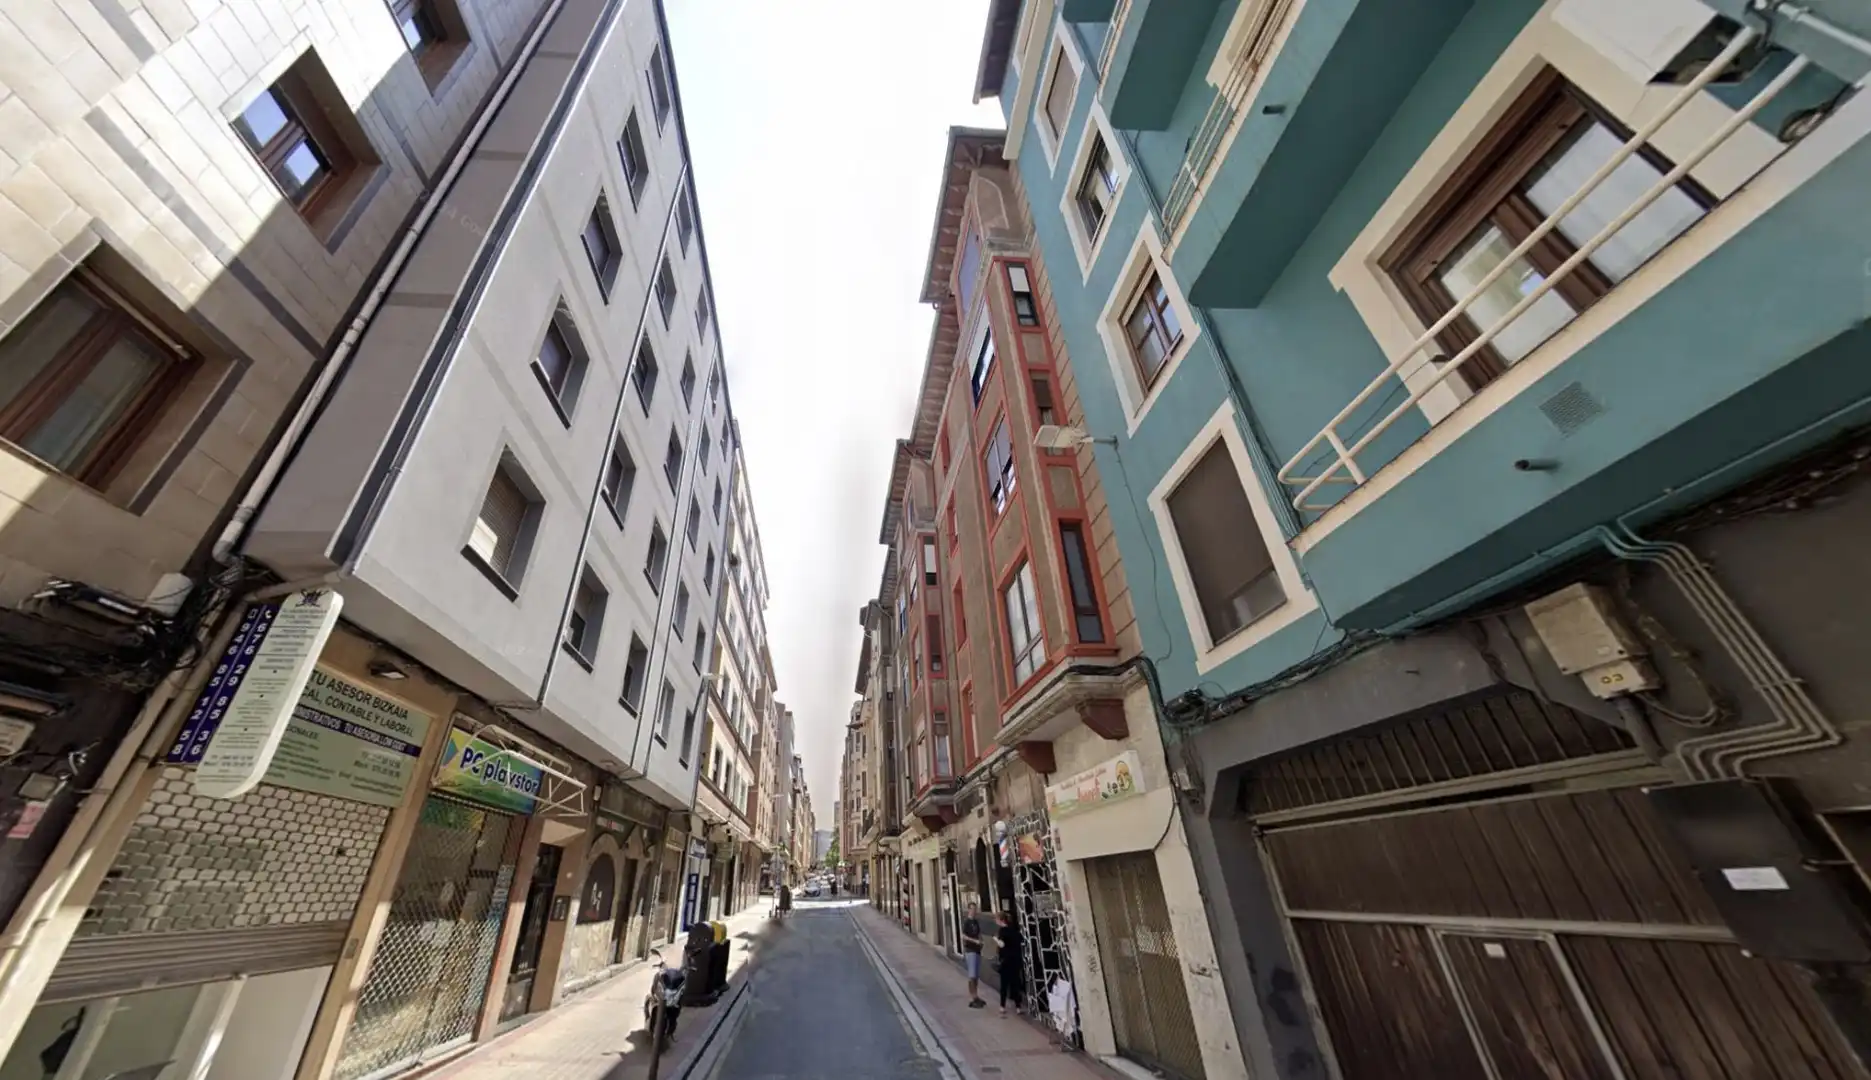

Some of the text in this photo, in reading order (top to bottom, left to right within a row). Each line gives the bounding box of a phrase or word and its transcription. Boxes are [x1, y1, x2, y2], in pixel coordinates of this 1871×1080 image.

[172, 623, 251, 755] 946 85 12 58
[191, 623, 267, 755] 676 29 85 36
[311, 670, 409, 720] TU ASESOR BIZKAIA
[324, 695, 373, 722] CONTABLE
[380, 717, 414, 738] LABORAL
[460, 747, 483, 774] PC
